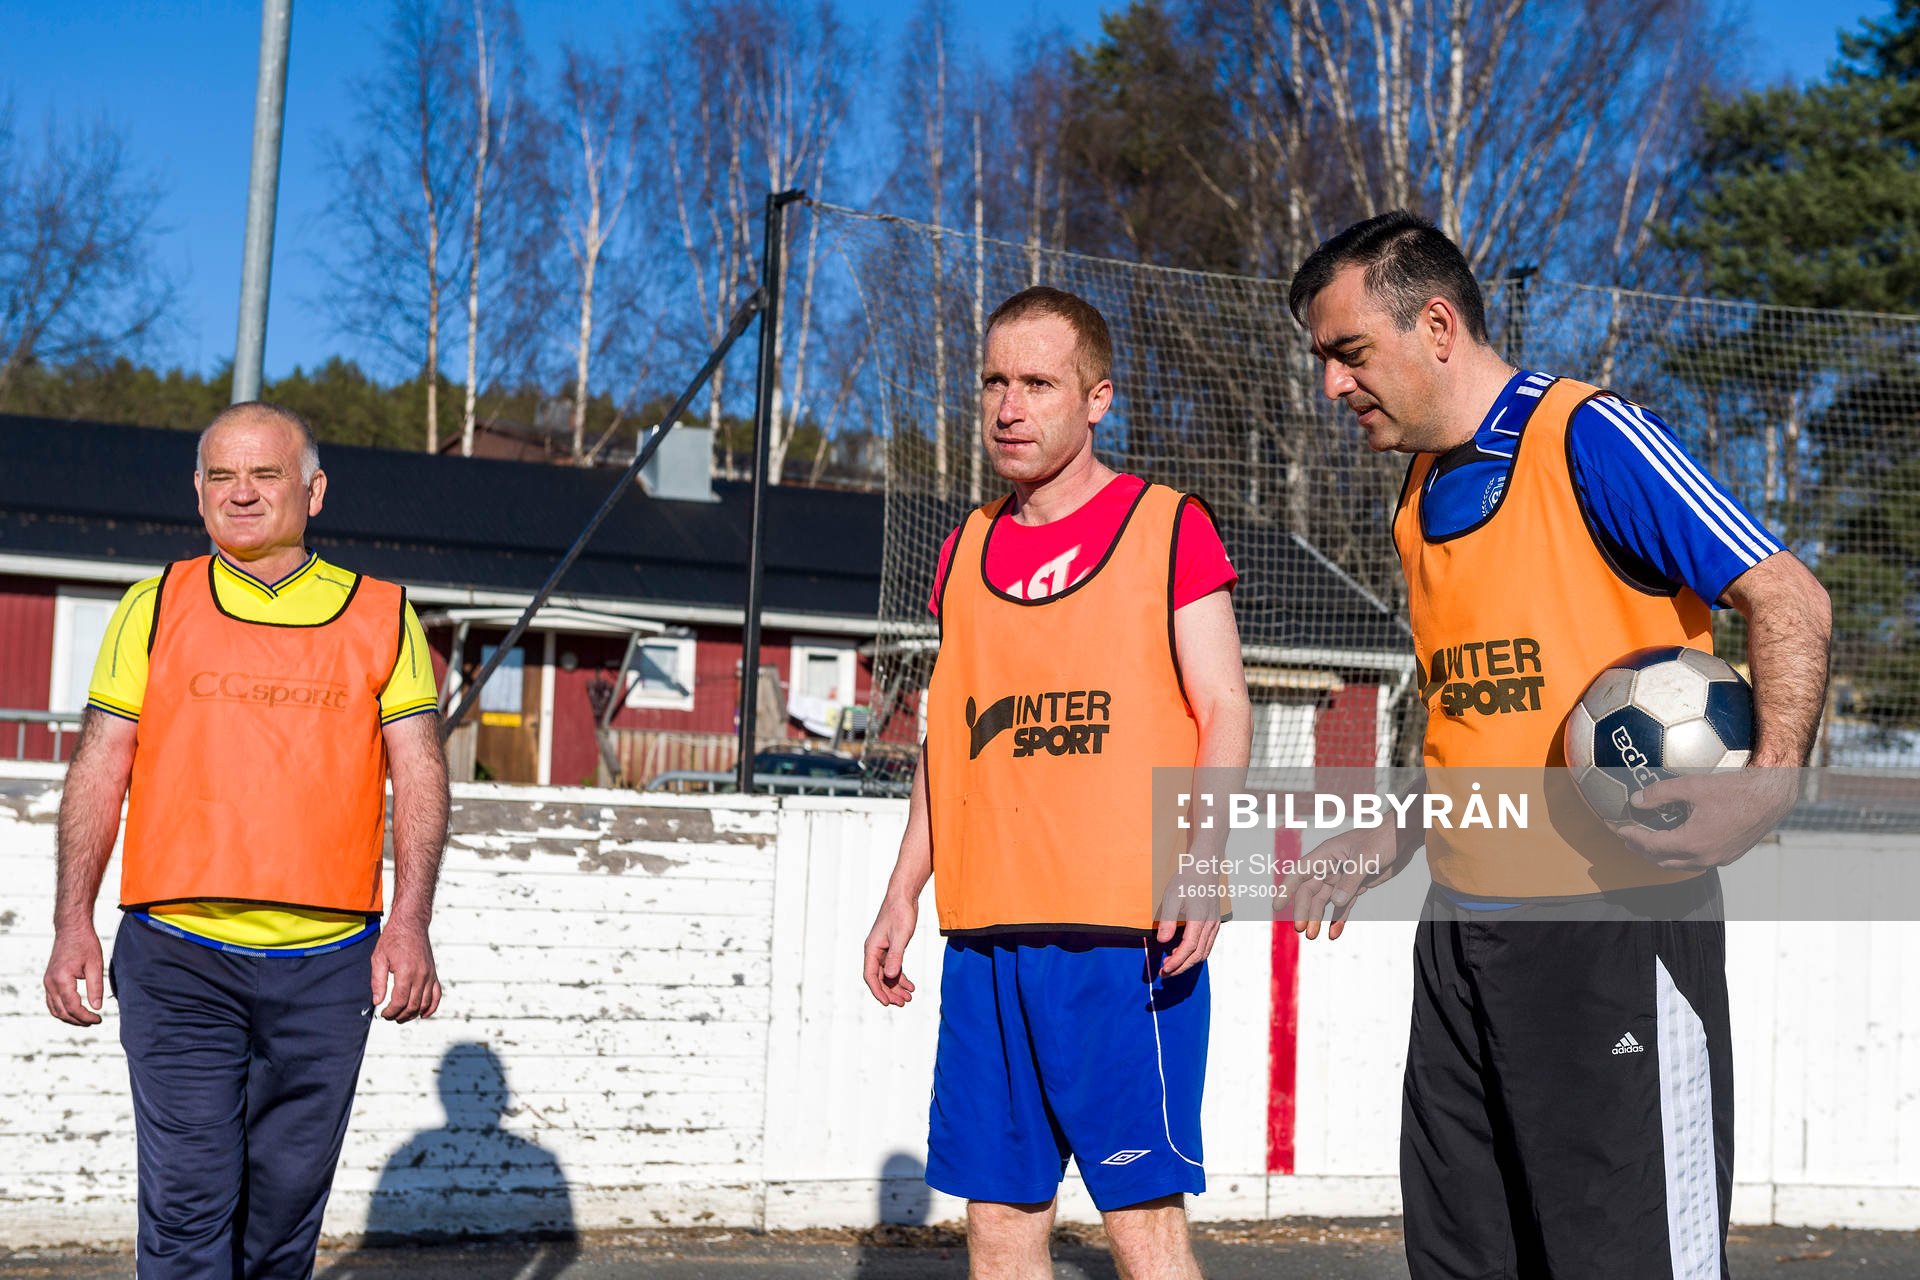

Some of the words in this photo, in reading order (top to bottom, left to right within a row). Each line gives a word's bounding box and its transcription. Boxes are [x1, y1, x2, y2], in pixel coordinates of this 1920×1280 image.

[1447, 637, 1542, 680] INTER
[1016, 690, 1112, 725] INTER
[1441, 676, 1545, 717] SPORT
[1013, 724, 1110, 758] SPORT
[1612, 725, 1684, 823] Kppa
[1611, 1045, 1644, 1055] adidas
